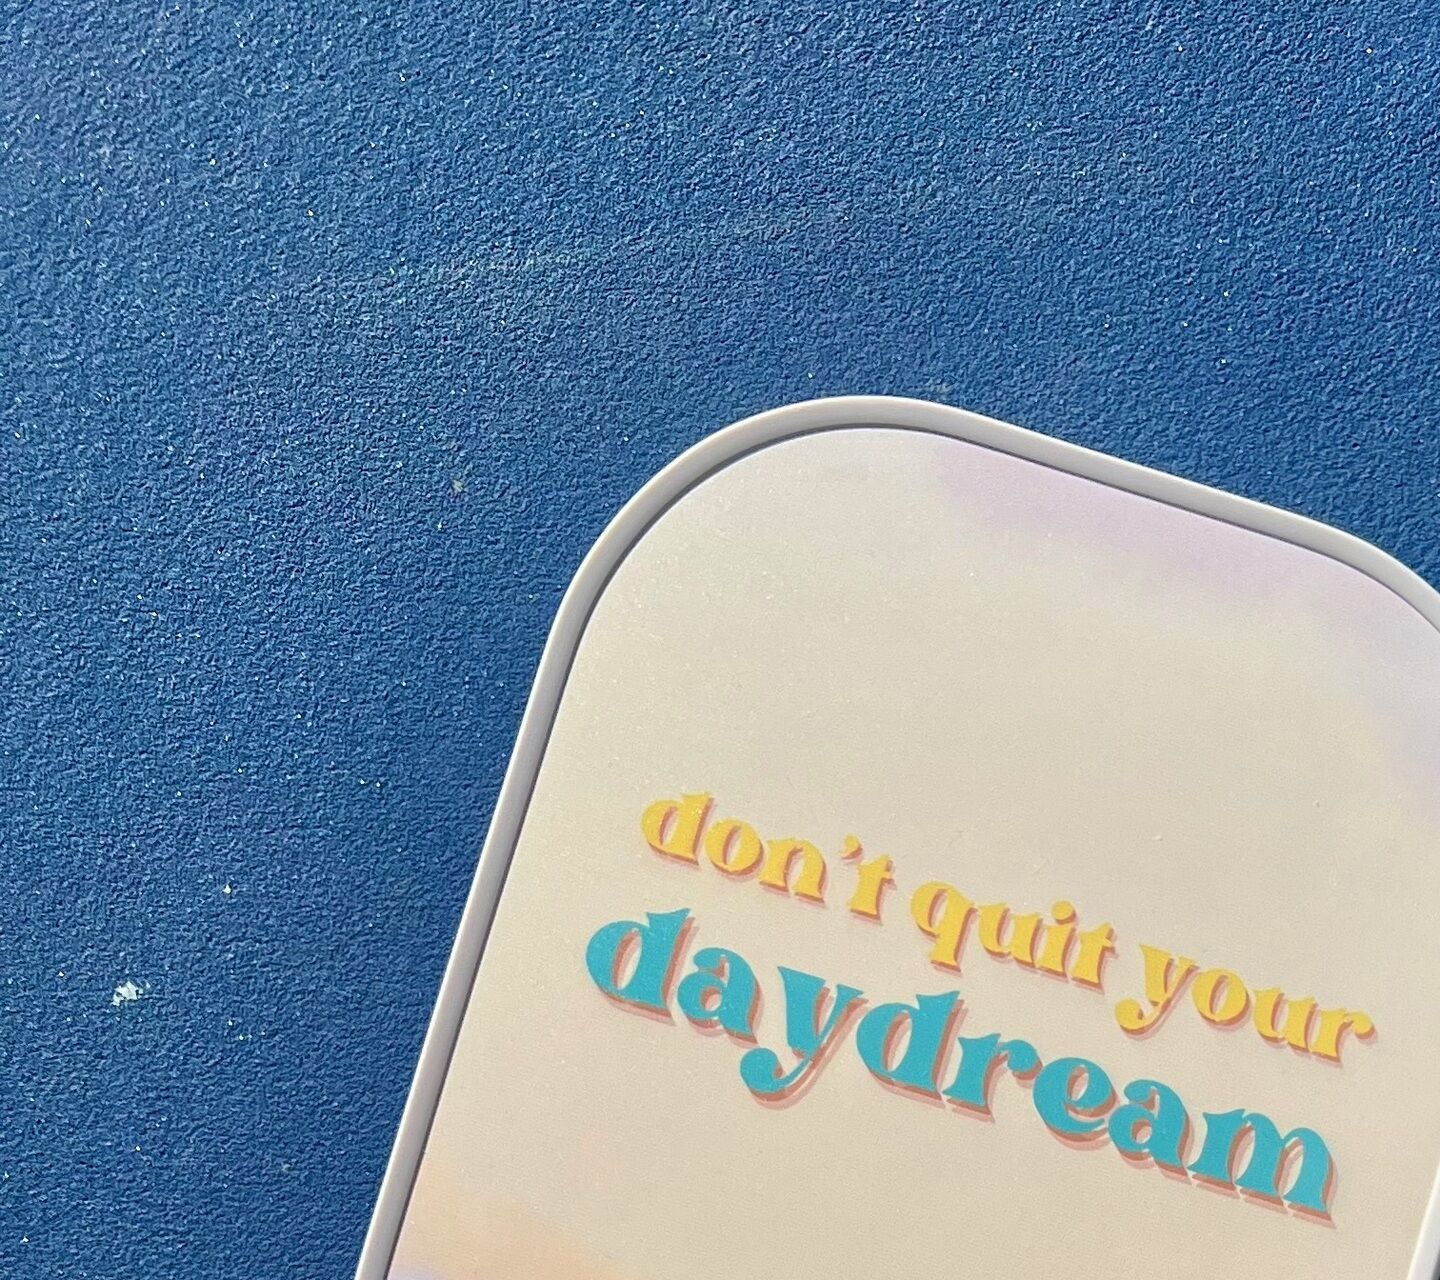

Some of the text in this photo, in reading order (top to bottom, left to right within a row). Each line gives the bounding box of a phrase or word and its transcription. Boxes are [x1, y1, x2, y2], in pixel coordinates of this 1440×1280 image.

[585, 907, 1339, 1227] daydream
[640, 791, 1377, 1066] don't quit your
